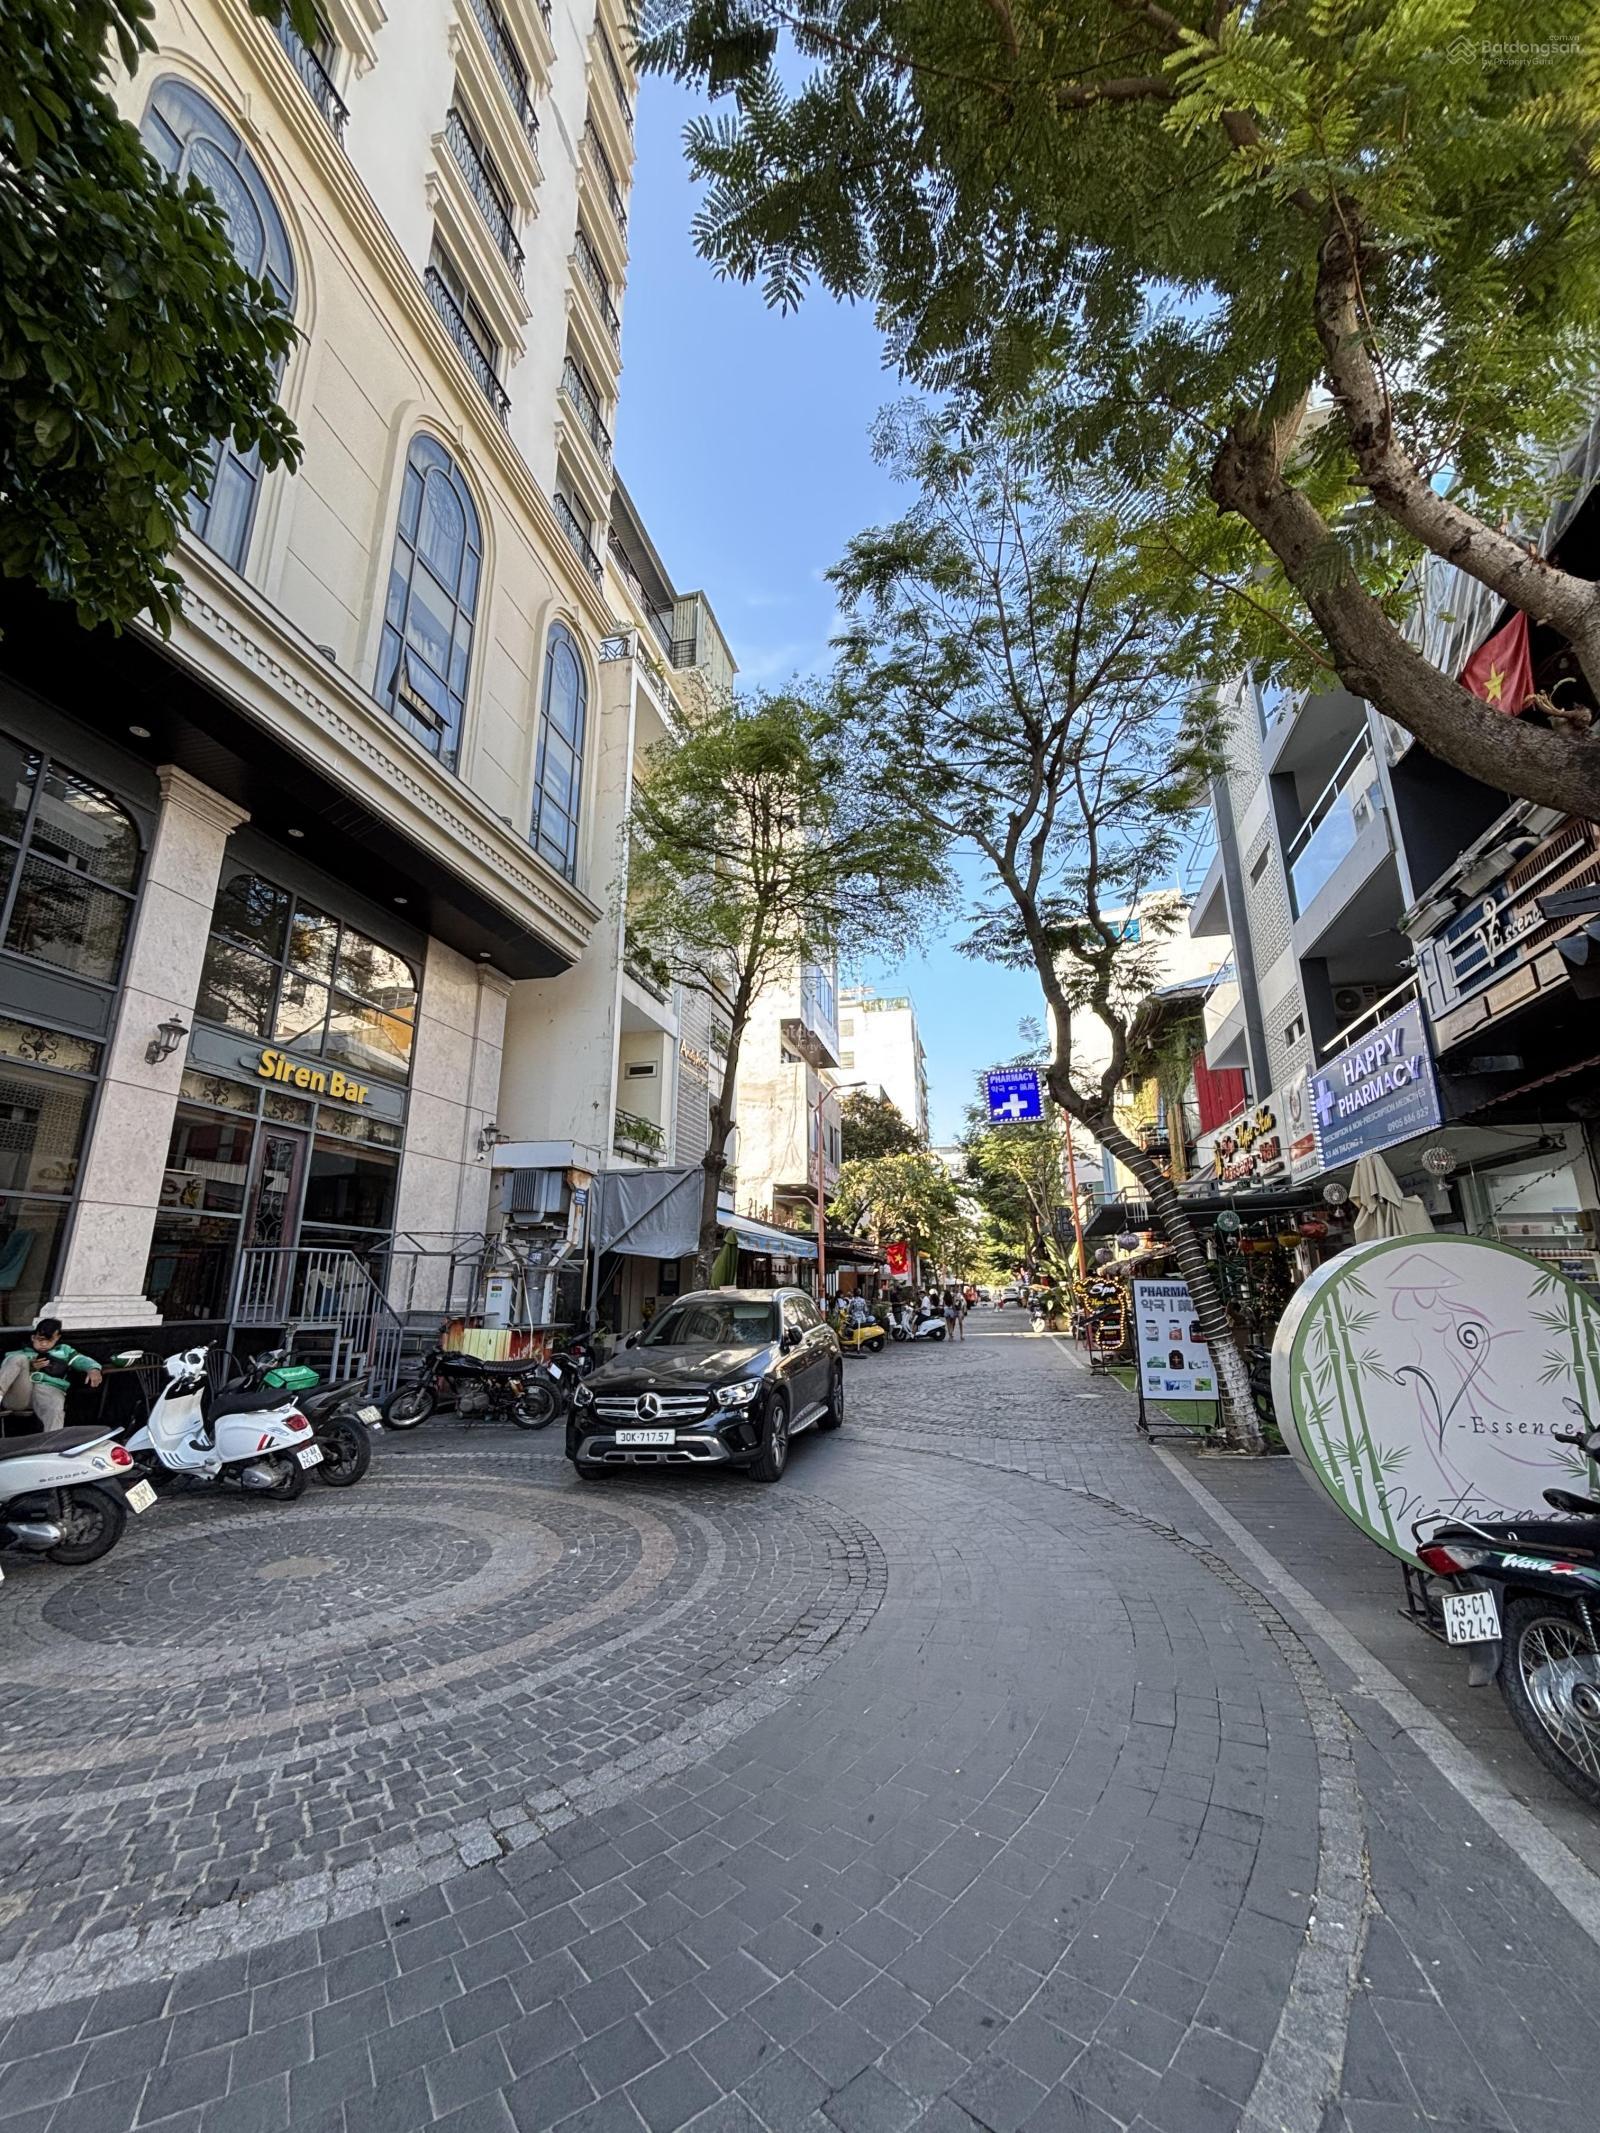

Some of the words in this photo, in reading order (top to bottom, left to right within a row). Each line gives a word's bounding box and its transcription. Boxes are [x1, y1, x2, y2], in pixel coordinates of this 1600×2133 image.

[1343, 1028, 1402, 1086] HAPPY
[258, 1049, 326, 1093] Siren
[330, 1070, 369, 1104] Bar
[990, 1072, 1033, 1084] PHARMACY
[1338, 1056, 1419, 1118] PHARMACY
[1089, 1283, 1117, 1297] Spa
[1140, 1286, 1189, 1298] PHARMA
[620, 1432, 669, 1442] 30K-717.57
[1501, 1553, 1556, 1571] Wave
[1451, 1596, 1487, 1617] 43-C1
[1450, 1616, 1499, 1642] 462.42
